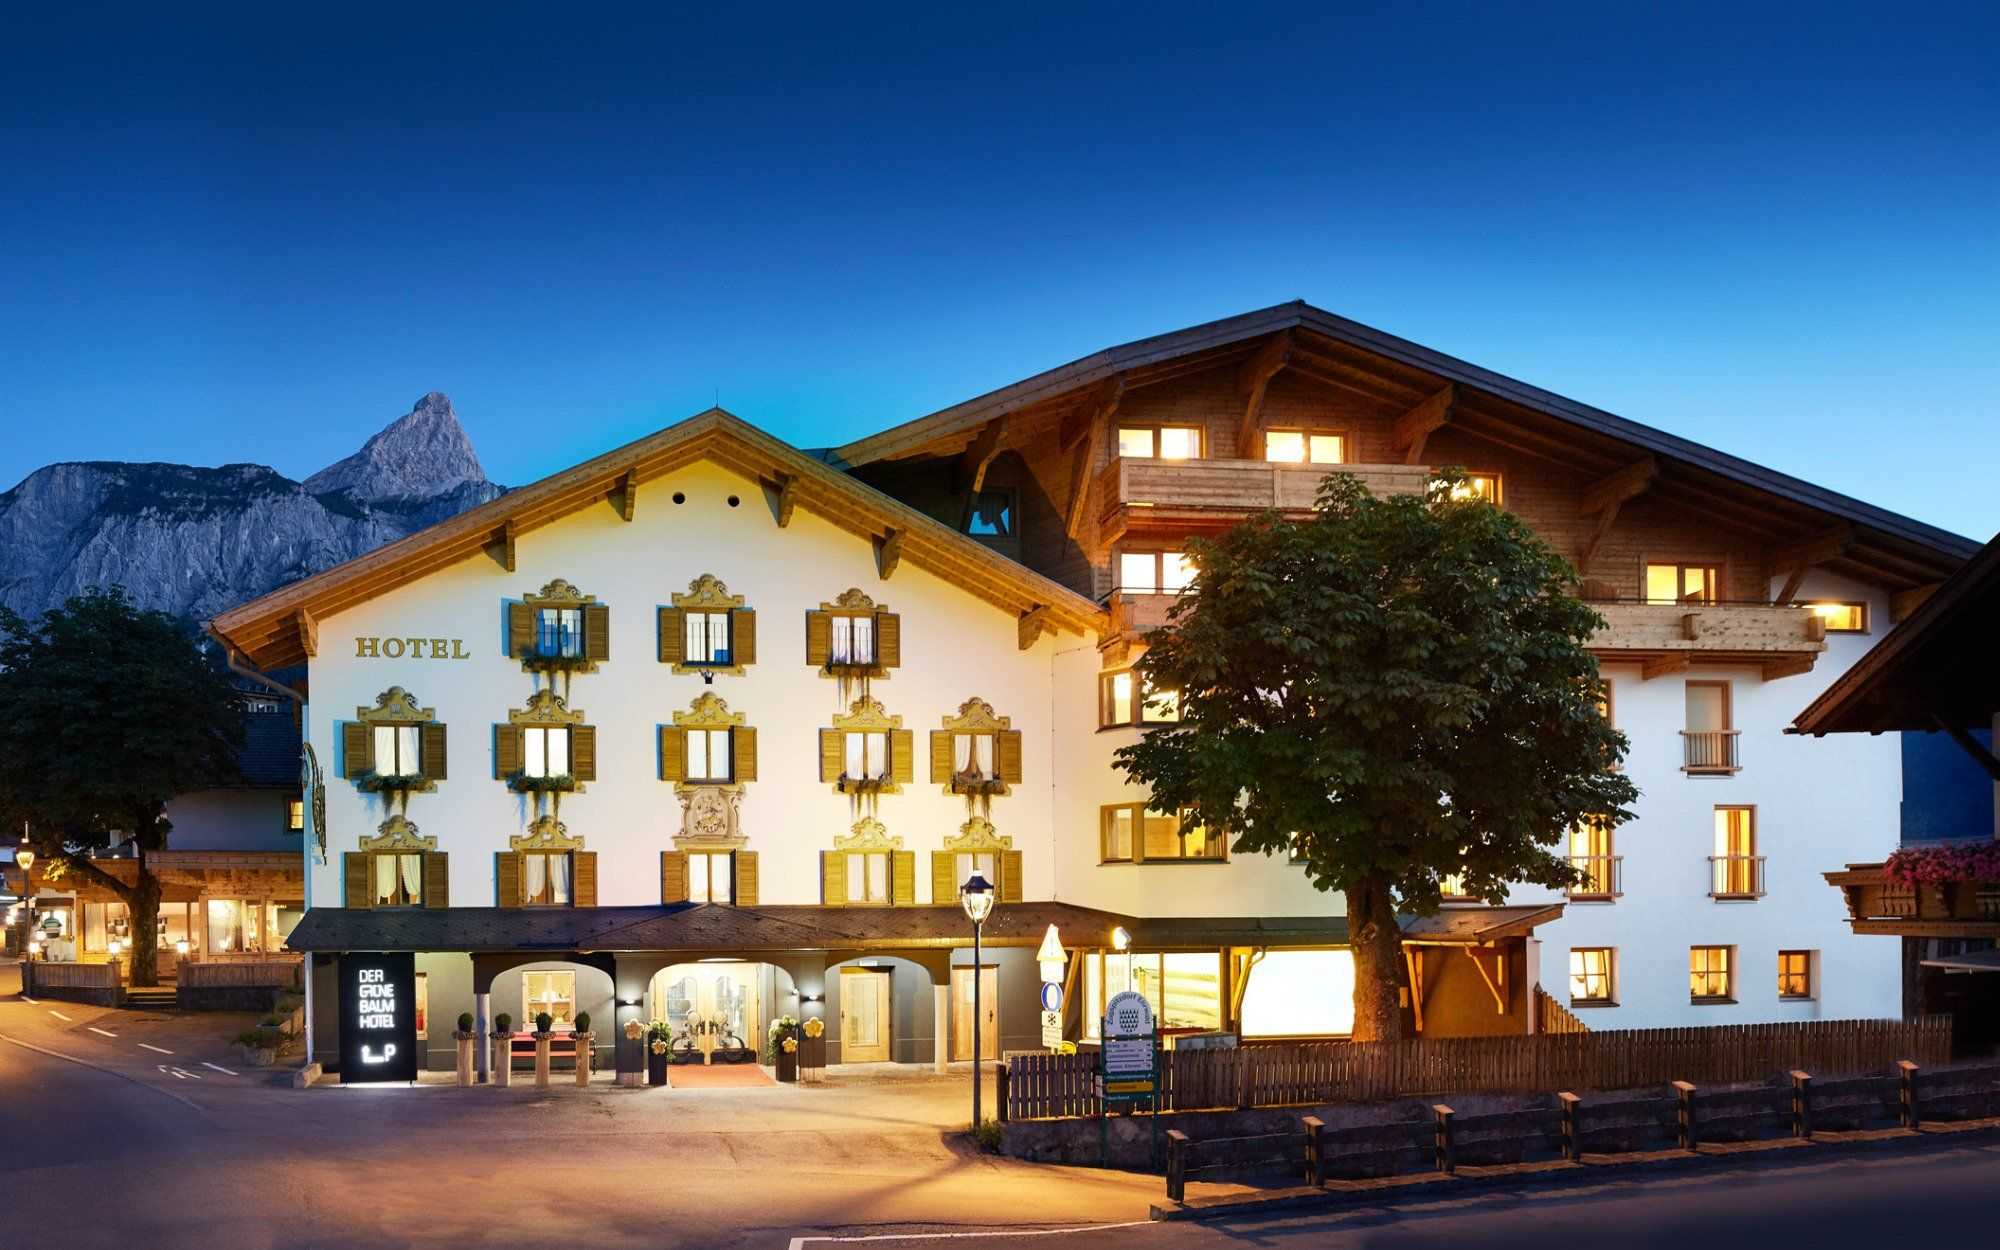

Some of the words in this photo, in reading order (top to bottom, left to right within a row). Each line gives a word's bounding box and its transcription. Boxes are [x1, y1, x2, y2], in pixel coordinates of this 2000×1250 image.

[355, 637, 470, 659] HOTEL
[359, 969, 384, 983] DER
[359, 999, 395, 1013] BAUM
[359, 1014, 395, 1028] HOTEL
[384, 1044, 396, 1062] P
